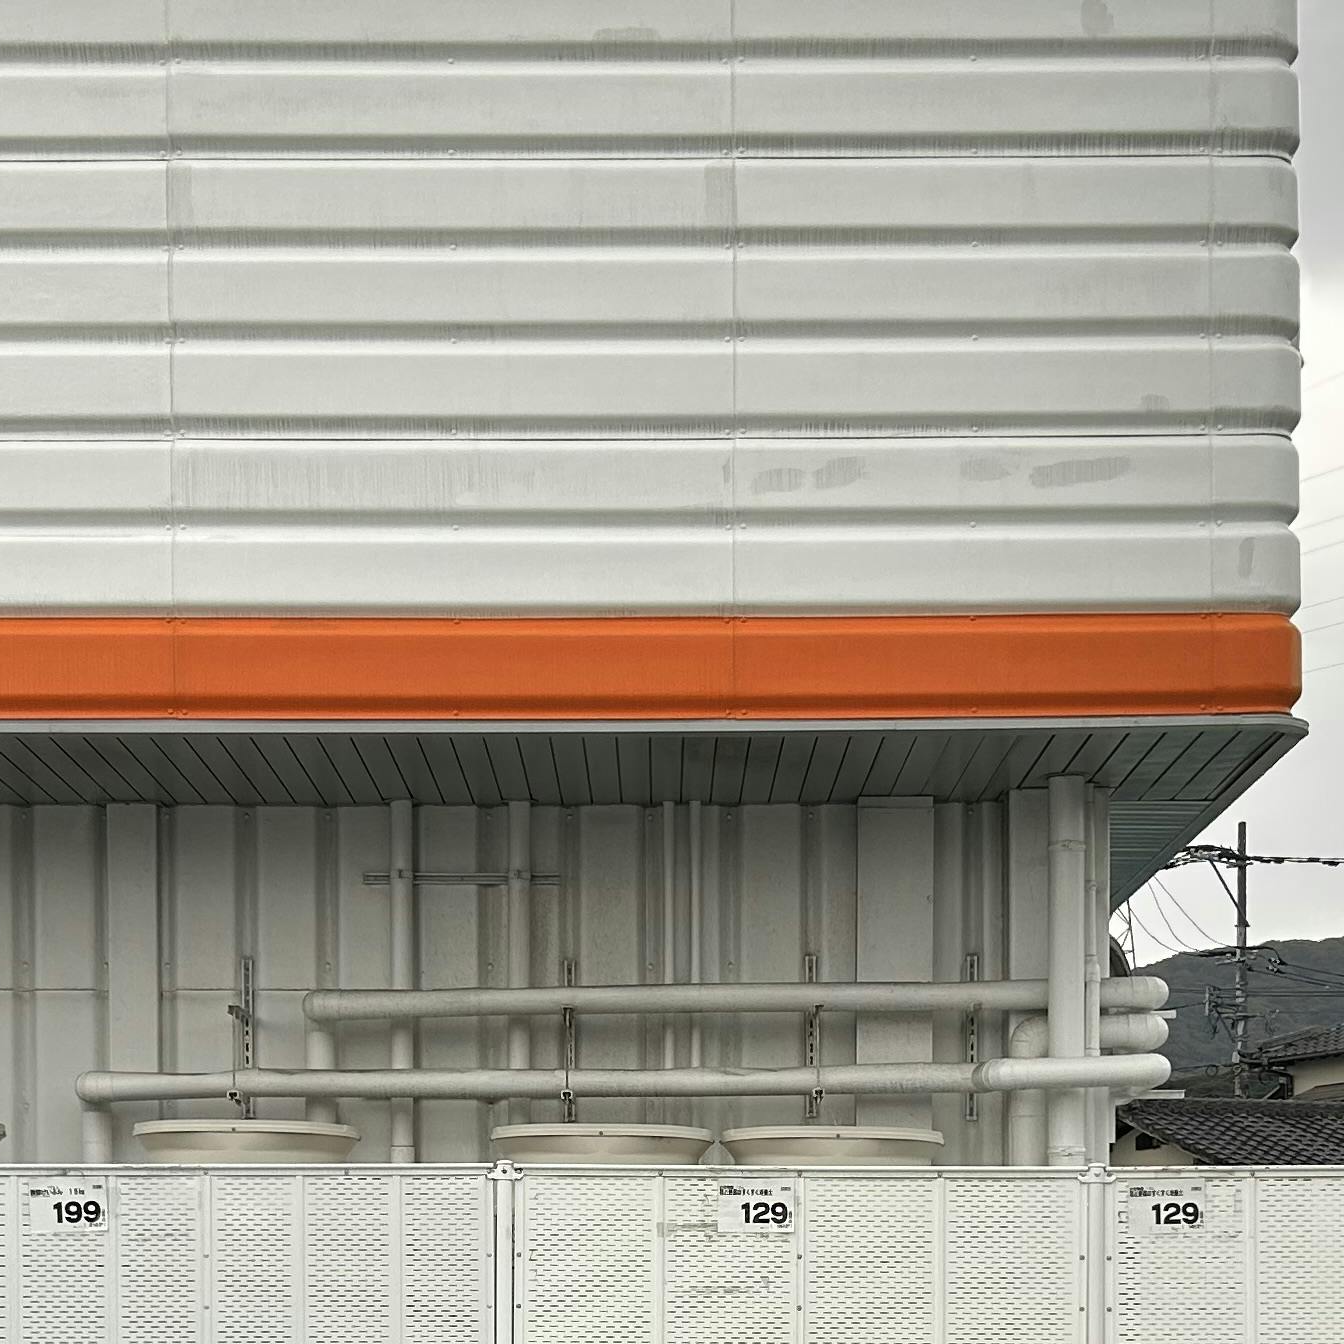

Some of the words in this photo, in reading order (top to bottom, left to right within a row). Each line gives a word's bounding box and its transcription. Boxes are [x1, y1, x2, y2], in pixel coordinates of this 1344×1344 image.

[53, 1201, 101, 1223] 199
[741, 1202, 788, 1224] 129
[1152, 1203, 1199, 1224] 129
